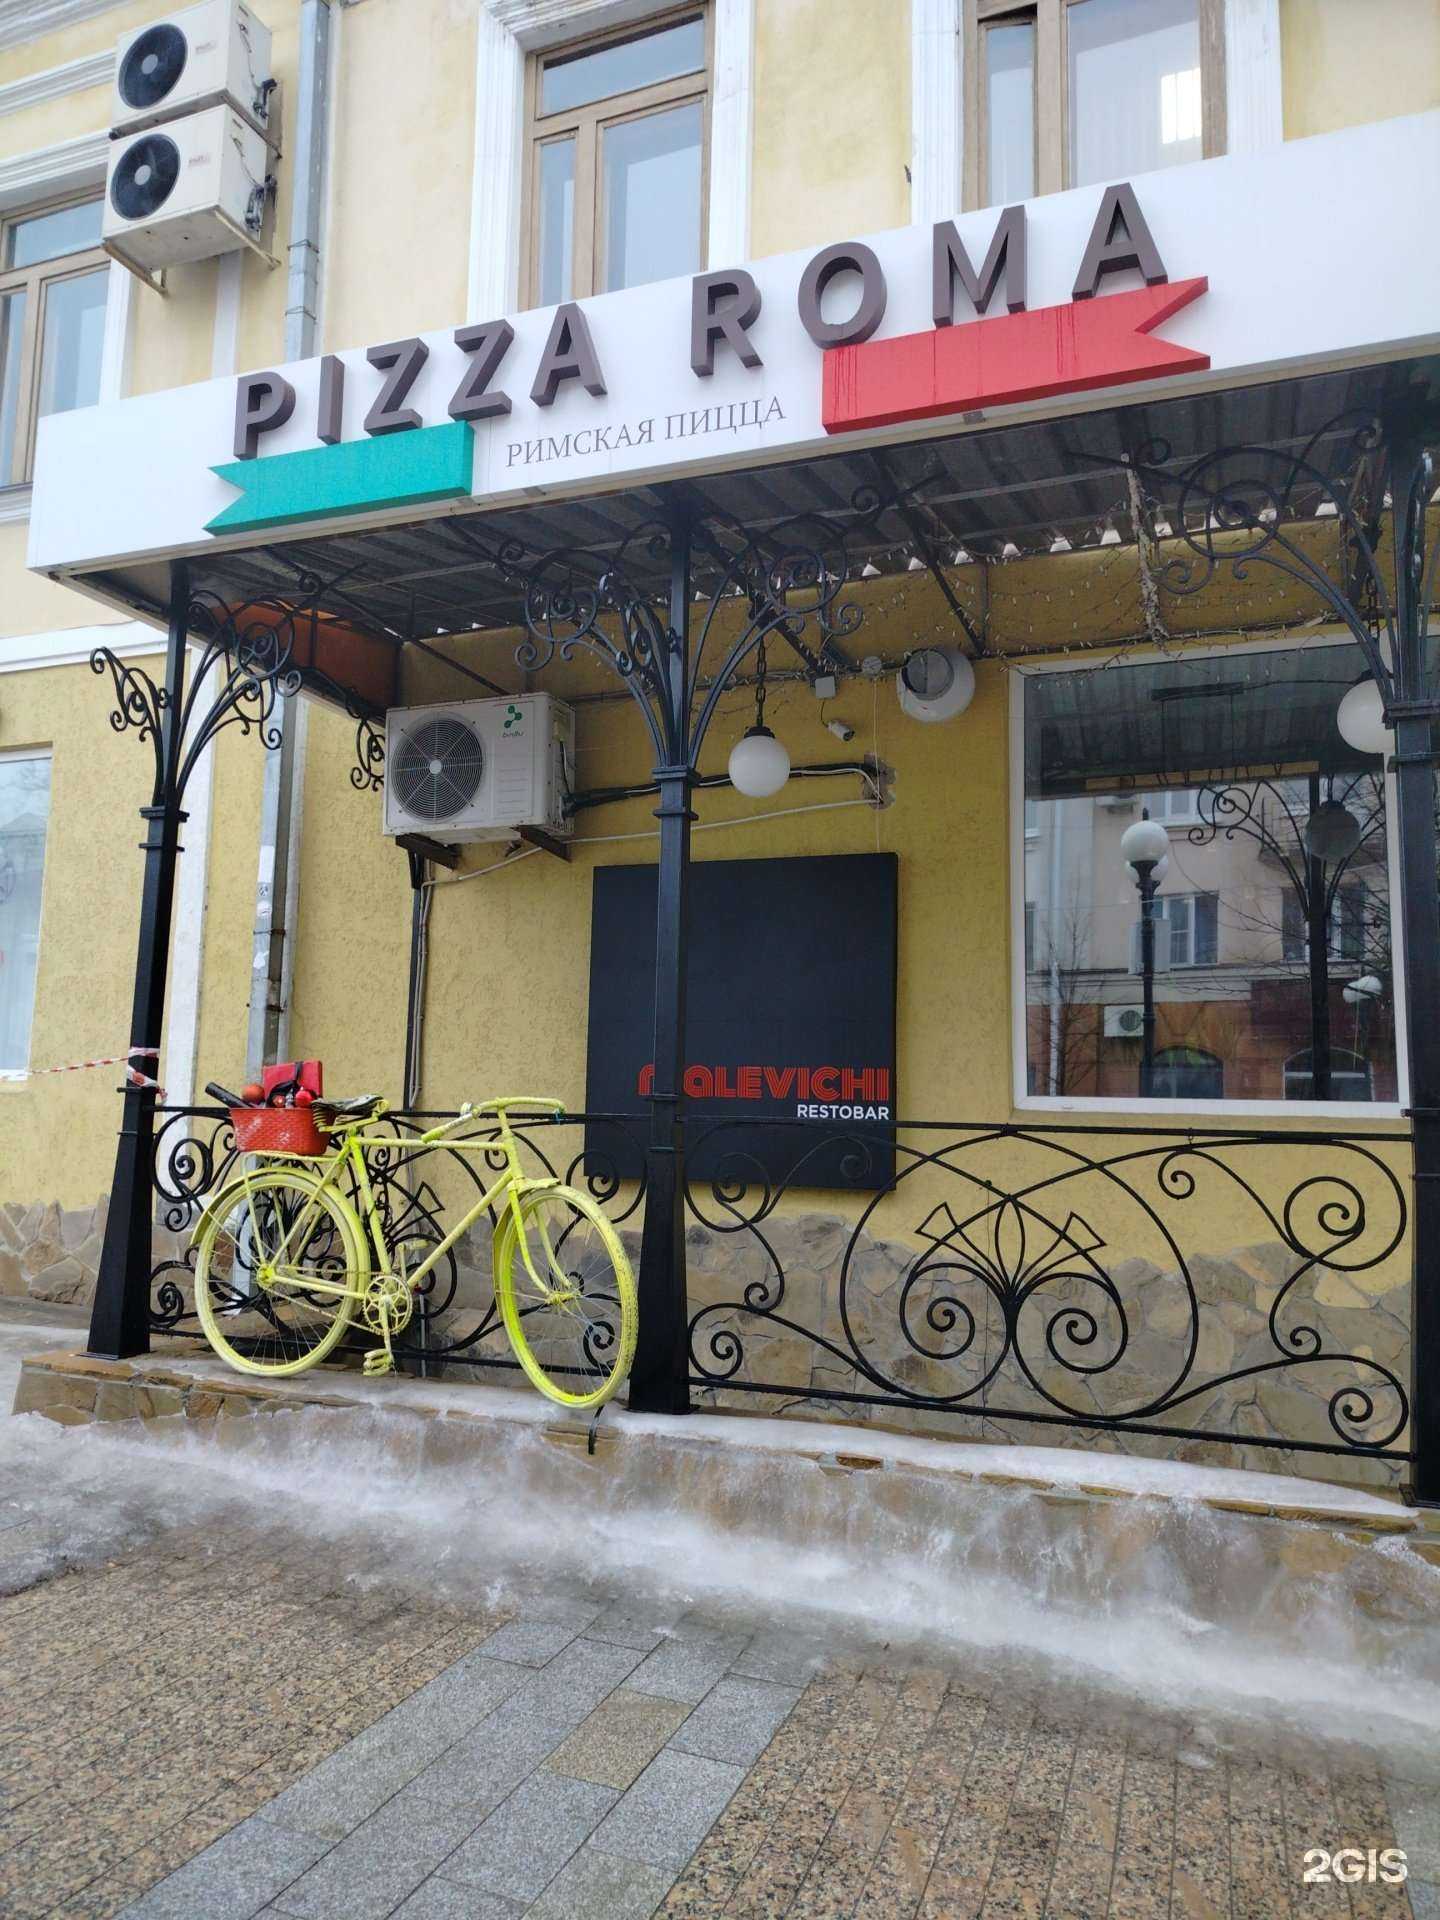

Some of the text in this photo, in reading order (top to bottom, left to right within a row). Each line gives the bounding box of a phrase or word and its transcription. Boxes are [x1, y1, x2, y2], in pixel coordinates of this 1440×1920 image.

[233, 182, 1168, 460] PIZZA ROMA
[505, 395, 787, 468] РИМСКАЯ ПИЦЦА
[796, 1104, 890, 1121] RESTOBAR
